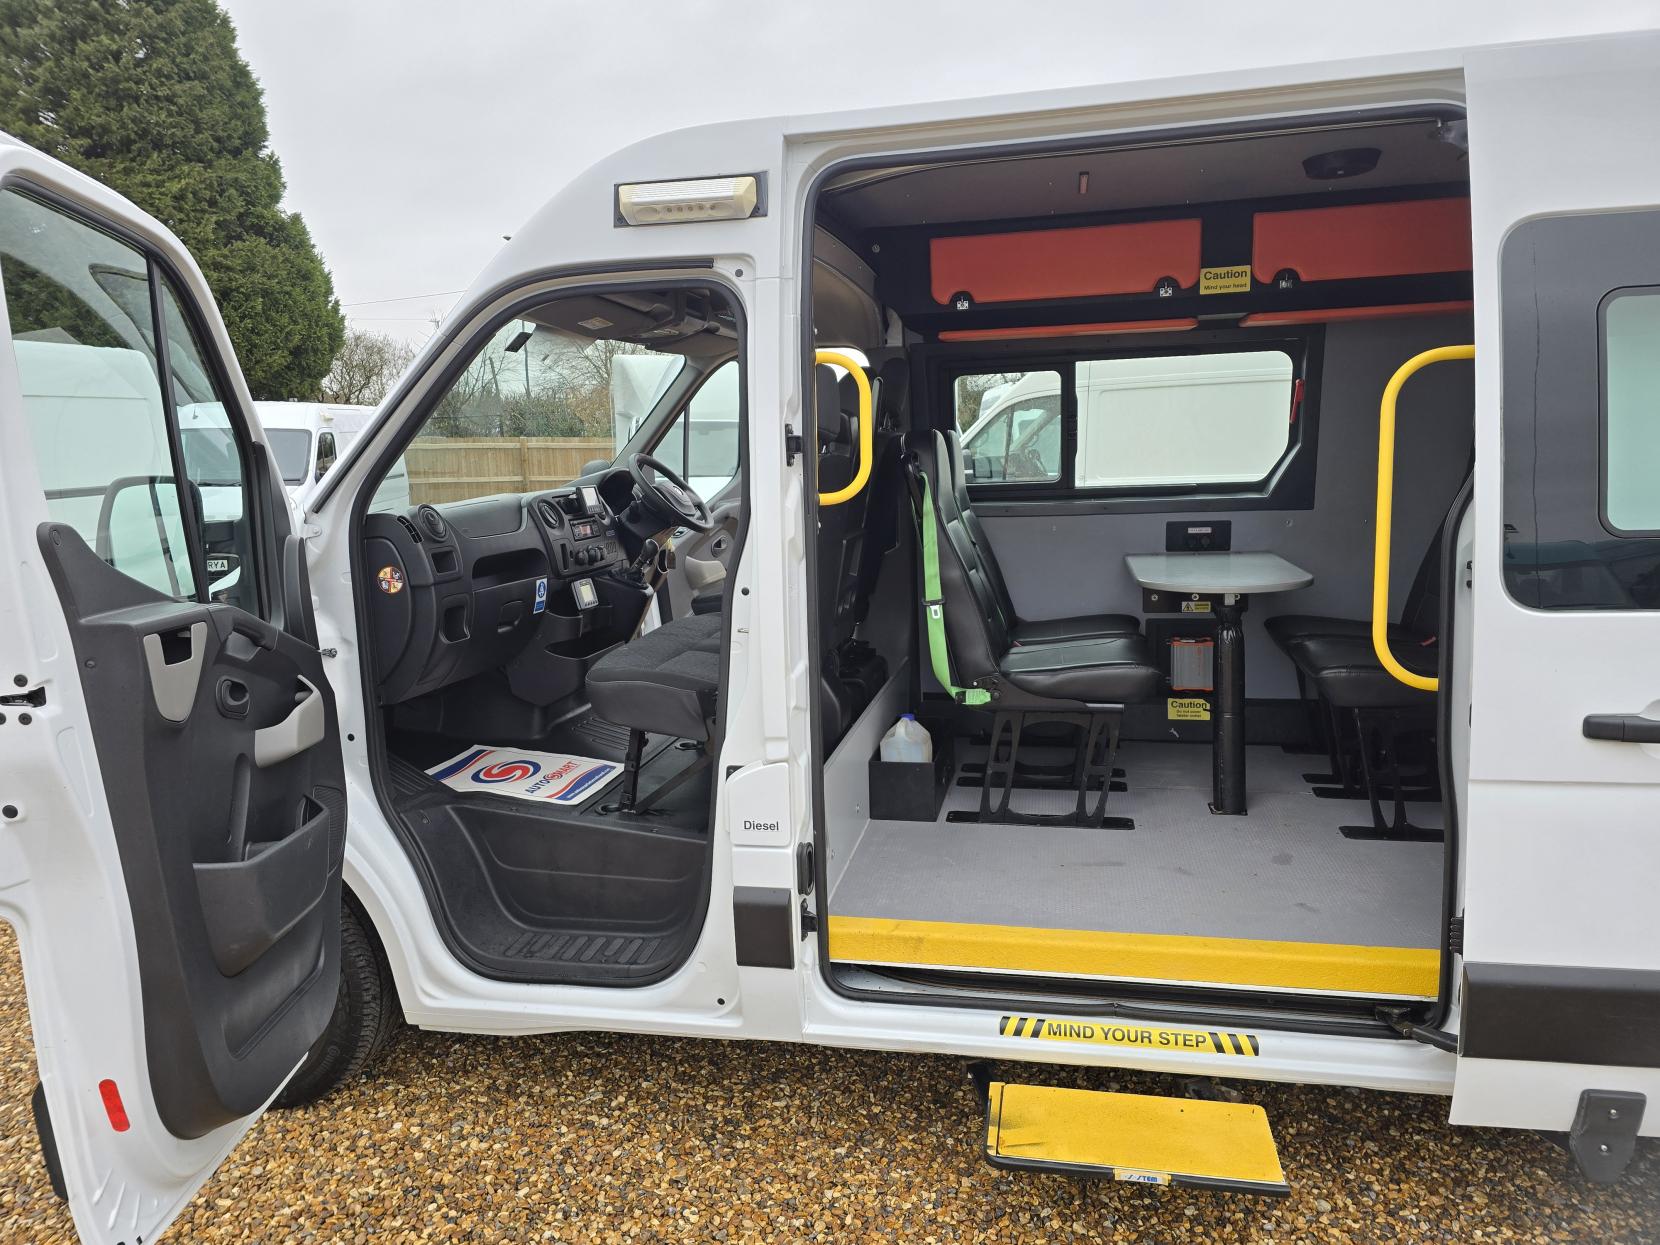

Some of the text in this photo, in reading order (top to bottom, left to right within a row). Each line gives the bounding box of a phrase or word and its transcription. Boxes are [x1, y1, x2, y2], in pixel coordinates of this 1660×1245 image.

[1204, 270, 1248, 281] Caution
[207, 561, 226, 569] RYA
[1170, 700, 1208, 709] Caution
[743, 820, 779, 831] Diesel
[1047, 1022, 1207, 1048] MIND YOUR STEP
